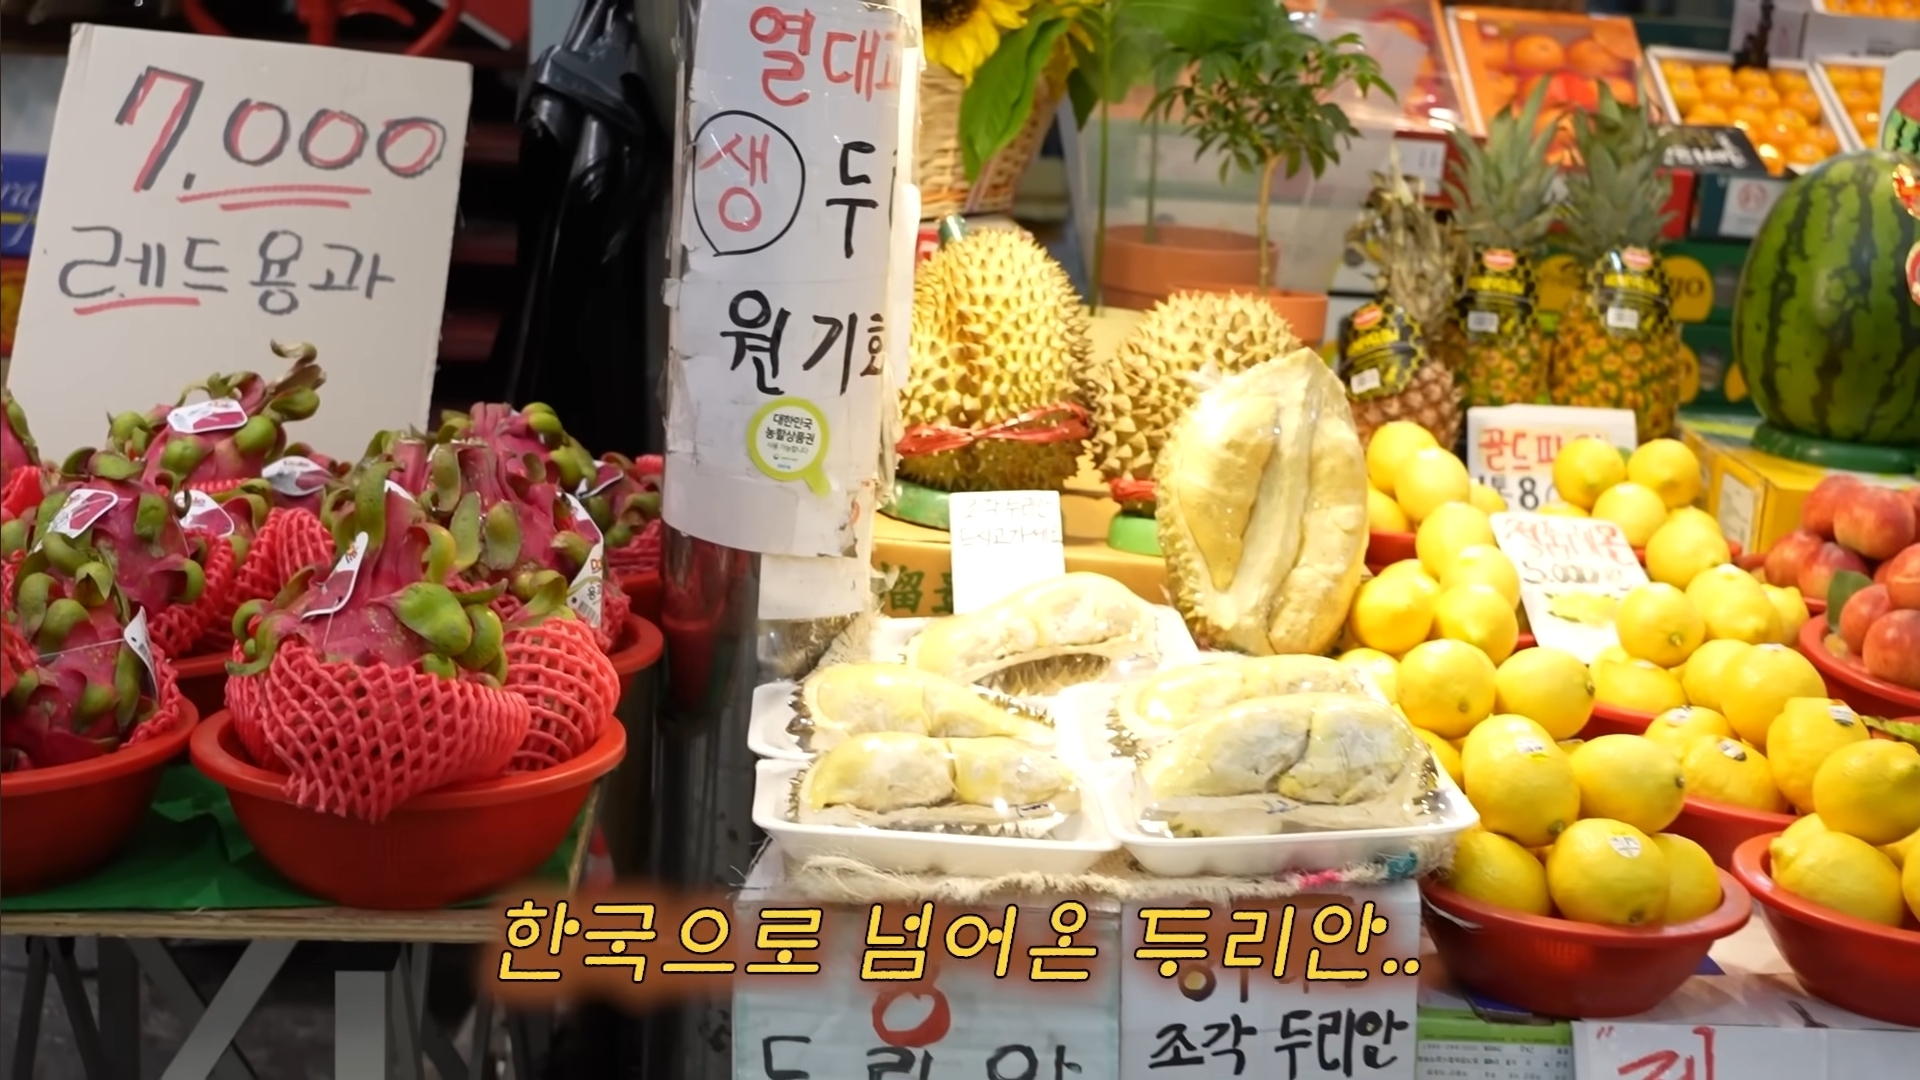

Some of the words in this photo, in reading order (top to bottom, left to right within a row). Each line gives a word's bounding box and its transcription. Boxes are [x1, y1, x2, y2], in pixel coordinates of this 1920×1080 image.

[115, 65, 446, 192] 7.000
[699, 133, 771, 233] 생
[825, 140, 897, 259] 두
[772, 413, 813, 430] 대한민국
[1478, 428, 1602, 471] 골드파
[1148, 1012, 1258, 1076] 조각
[1274, 1007, 1410, 1080] 두리안
